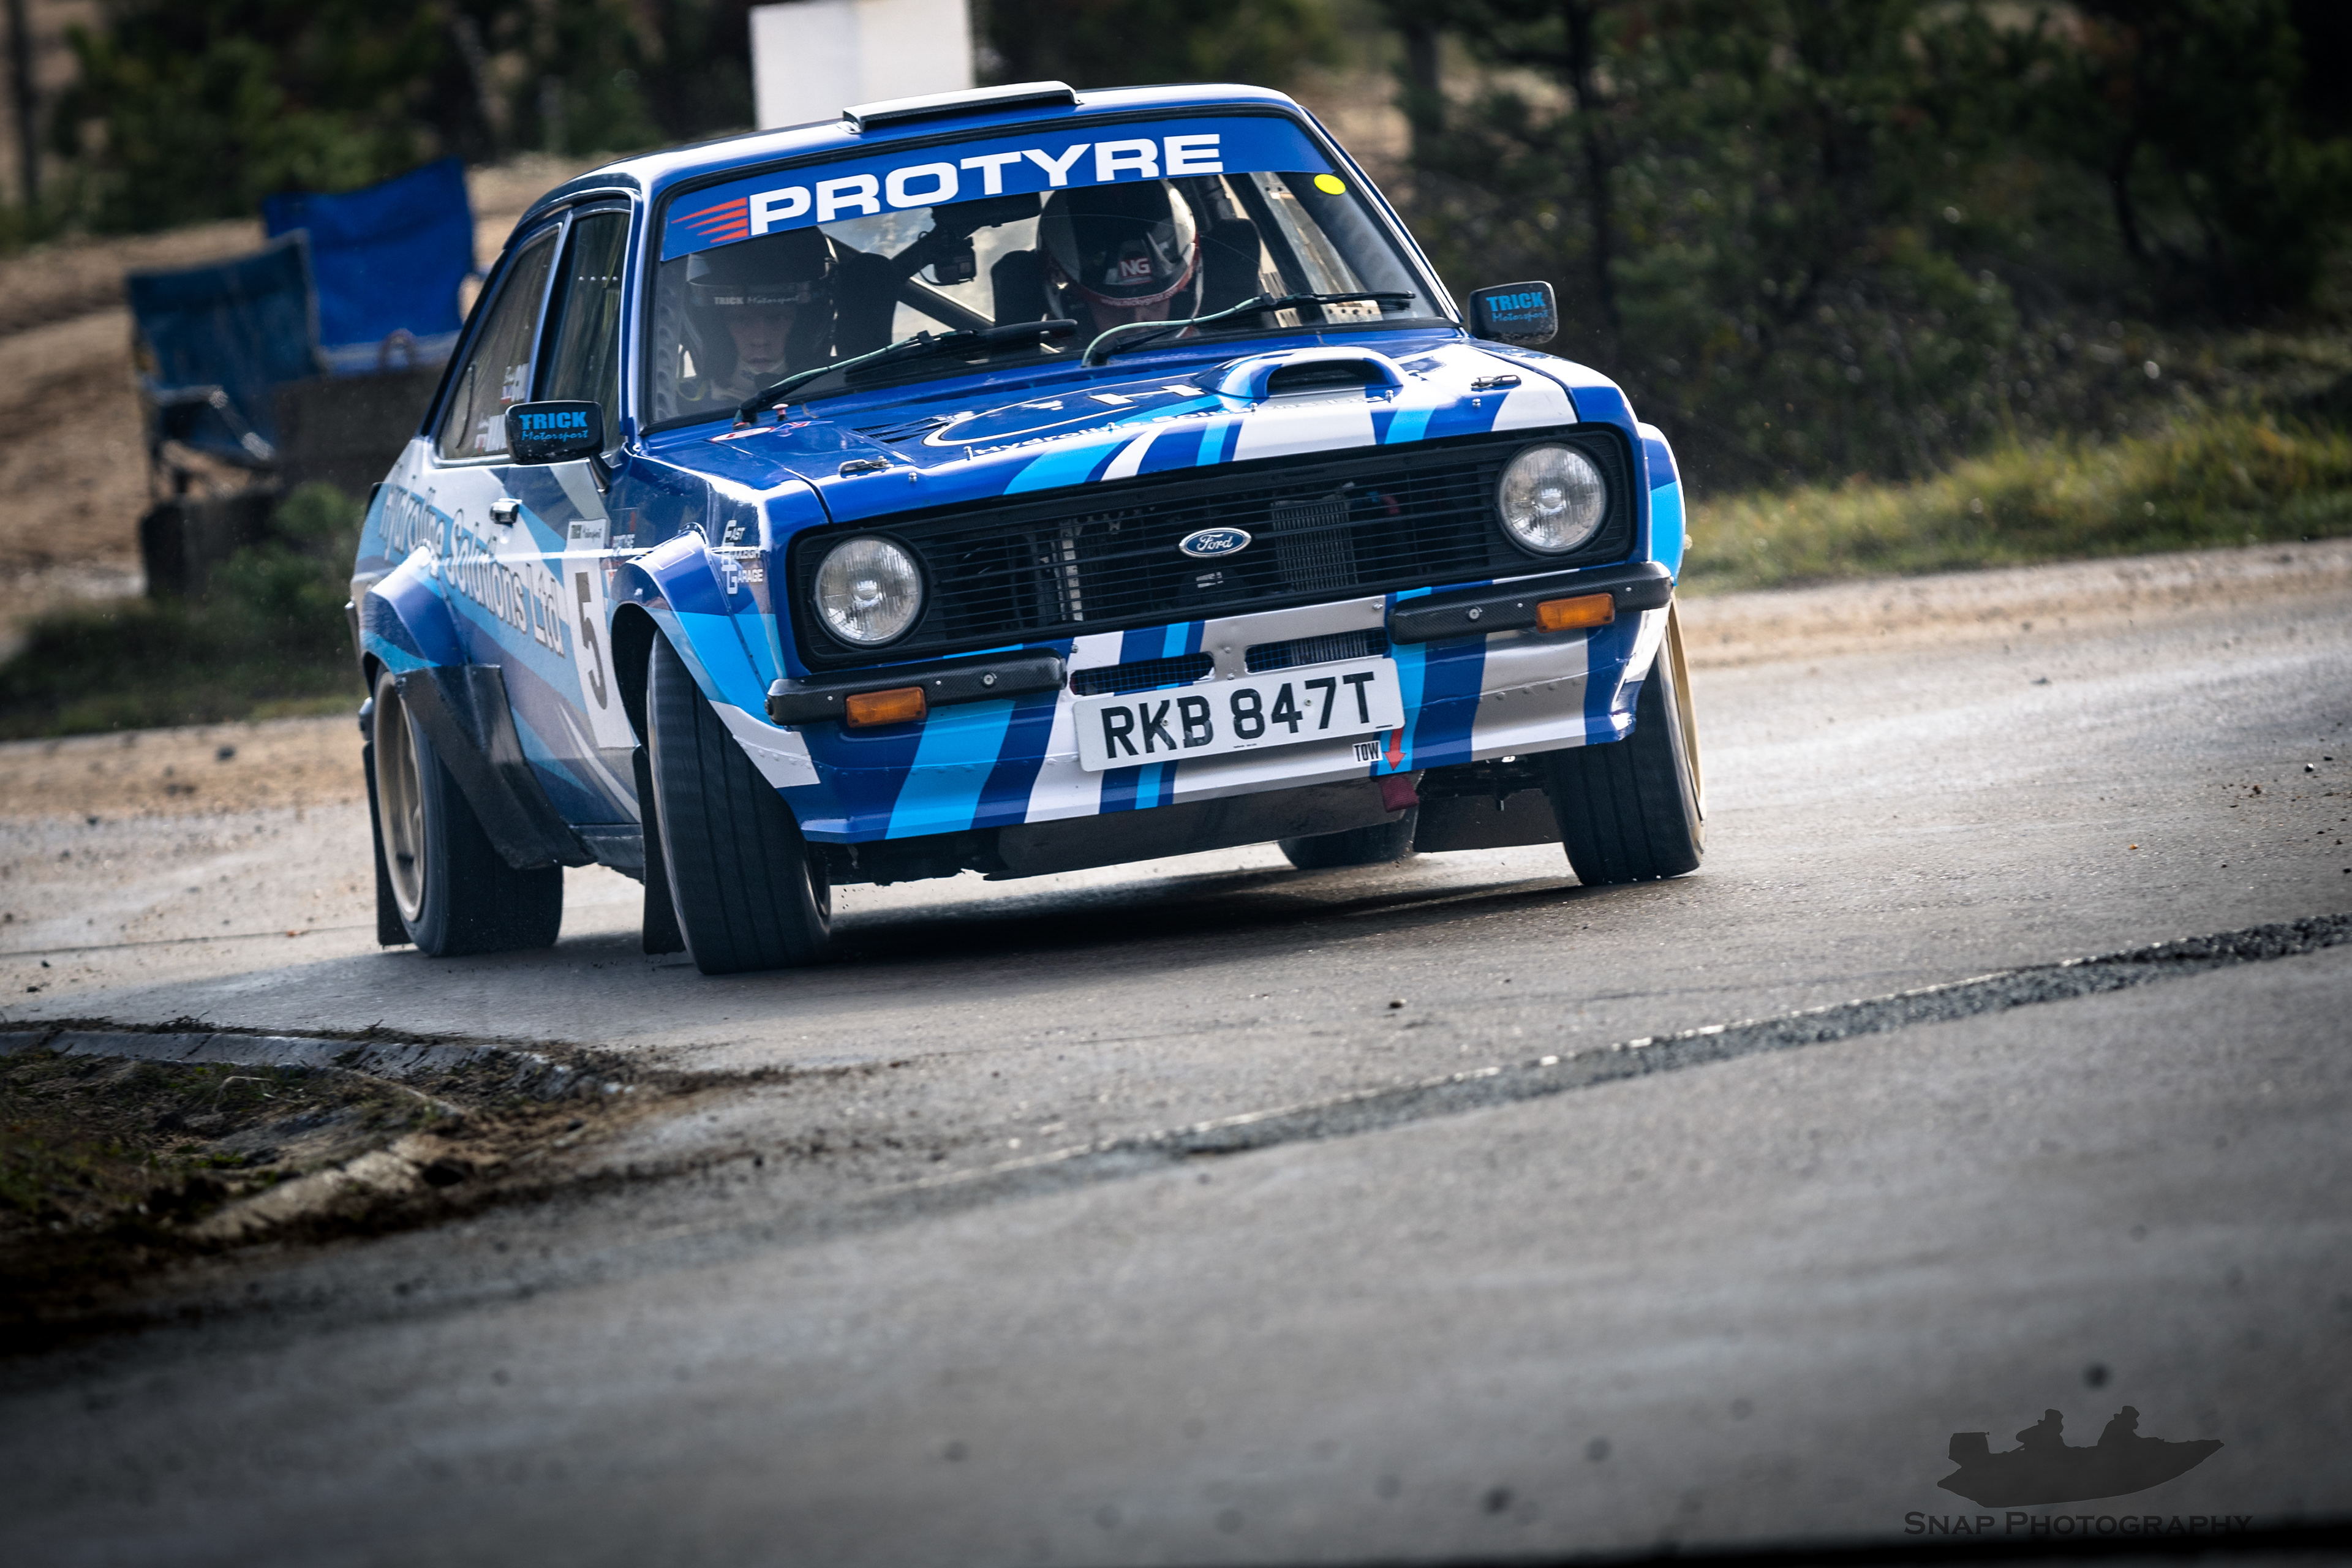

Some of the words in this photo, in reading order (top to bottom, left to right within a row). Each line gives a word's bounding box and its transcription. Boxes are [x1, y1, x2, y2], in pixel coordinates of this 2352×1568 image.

[748, 134, 1224, 237] PROTYRE
[1120, 257, 1150, 276] NG
[714, 296, 744, 305] TRICK
[1486, 292, 1545, 312] TRICK
[1492, 309, 1548, 322] Motorsport
[519, 412, 588, 430] TRICK
[521, 429, 589, 442] Motorsport
[1196, 533, 1234, 551] Ford
[444, 508, 528, 635] Solutions
[526, 562, 566, 658] Ltd
[575, 571, 608, 710] 5
[1101, 695, 1215, 760] RKB
[1230, 671, 1375, 740] 847T
[1354, 741, 1380, 762] TOW
